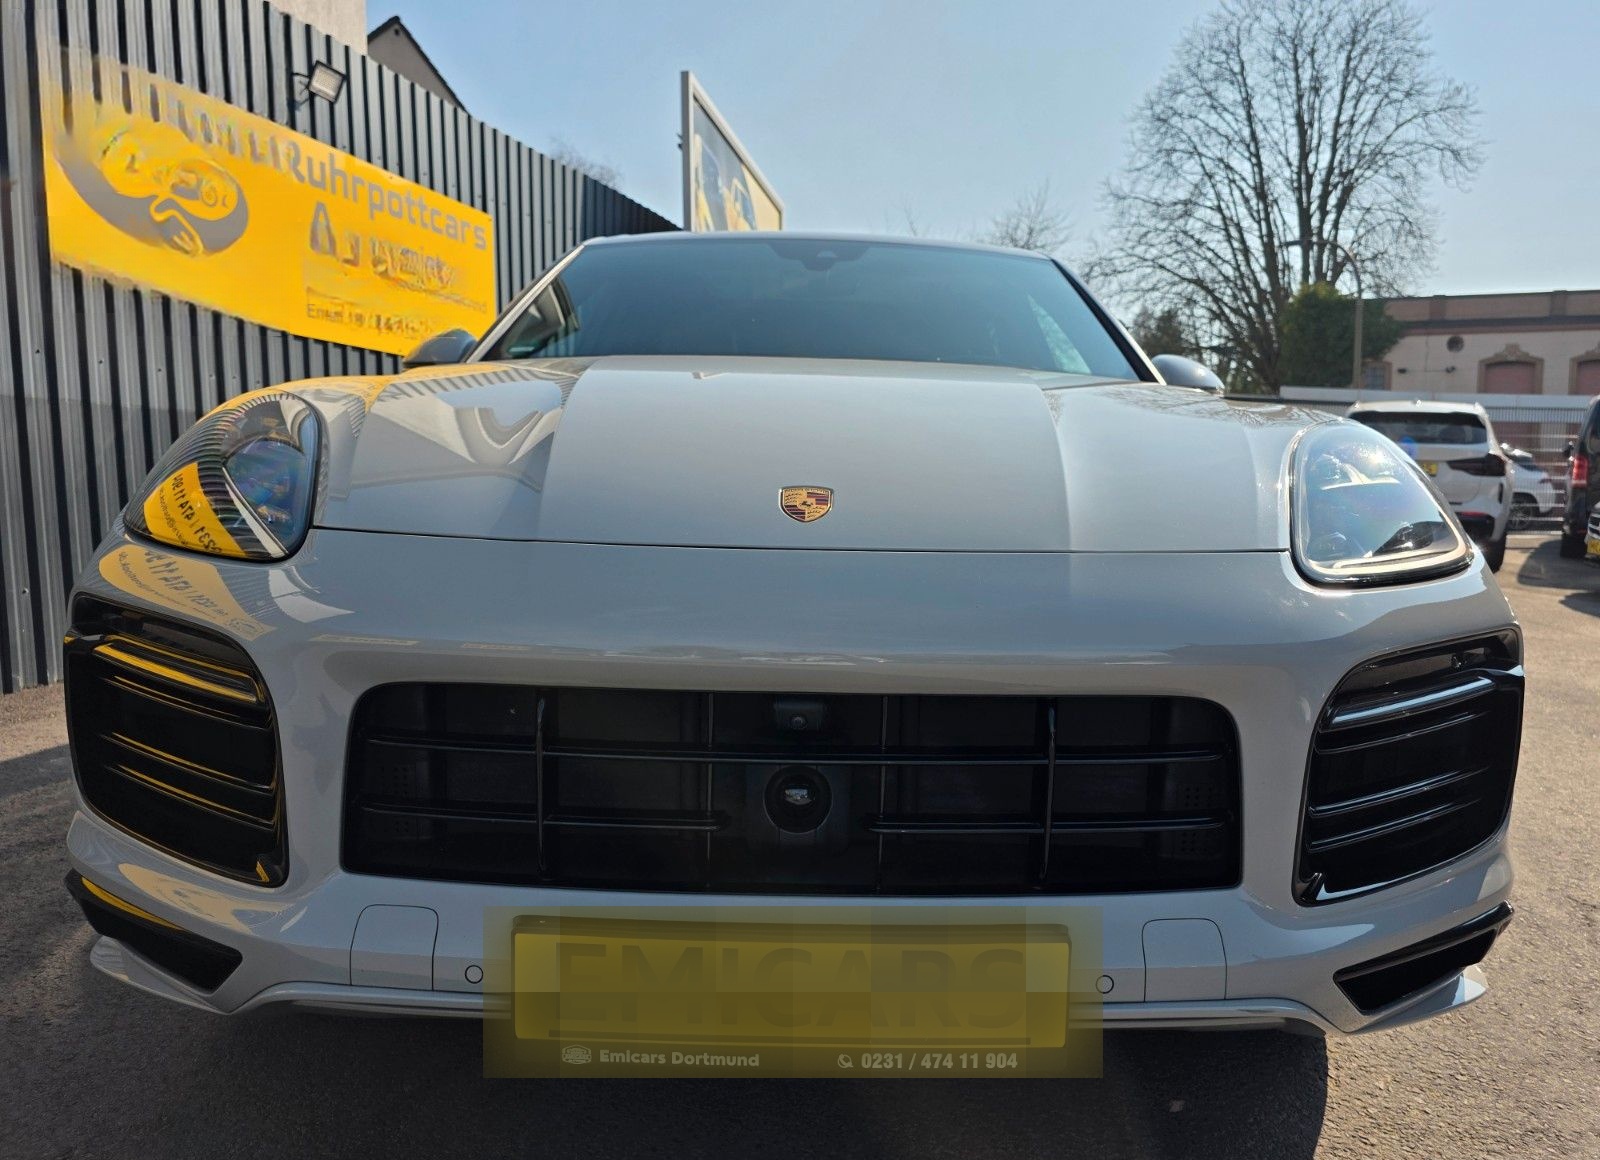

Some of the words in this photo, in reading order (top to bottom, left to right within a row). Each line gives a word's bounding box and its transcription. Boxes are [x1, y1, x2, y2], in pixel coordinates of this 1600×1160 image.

[554, 941, 1026, 1029] EMICARS
[599, 1049, 667, 1064] Emicars
[671, 1051, 760, 1067] Dortmund
[861, 1052, 903, 1069] 0231
[908, 1053, 917, 1070] /
[920, 1053, 954, 1069] 474
[959, 1053, 979, 1069] 11
[985, 1053, 1018, 1069] 904
